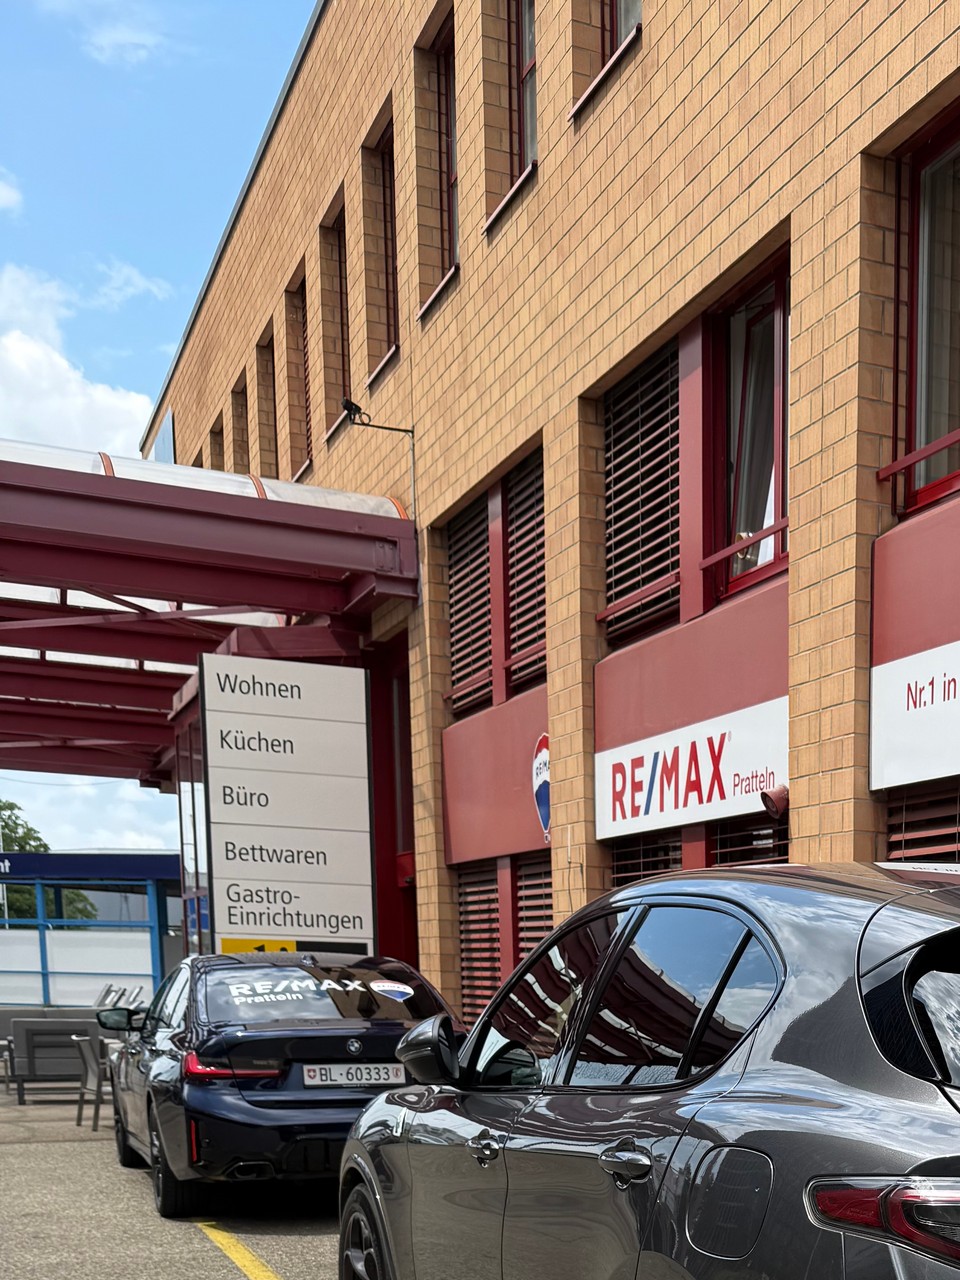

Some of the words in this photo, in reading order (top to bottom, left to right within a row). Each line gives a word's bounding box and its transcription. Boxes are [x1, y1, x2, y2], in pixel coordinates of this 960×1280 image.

[216, 672, 301, 700] Wohnen
[906, 675, 936, 712] Nr.1
[943, 672, 957, 702] in
[219, 729, 294, 754] Küchen
[611, 732, 727, 822] RE/MAX
[733, 766, 775, 797] Pratteln
[222, 785, 269, 808] Büro
[224, 841, 327, 866] Bettwaren
[226, 883, 300, 905] Gastro-
[227, 906, 363, 934] Einrichtungen
[228, 979, 367, 997] RE/MAX
